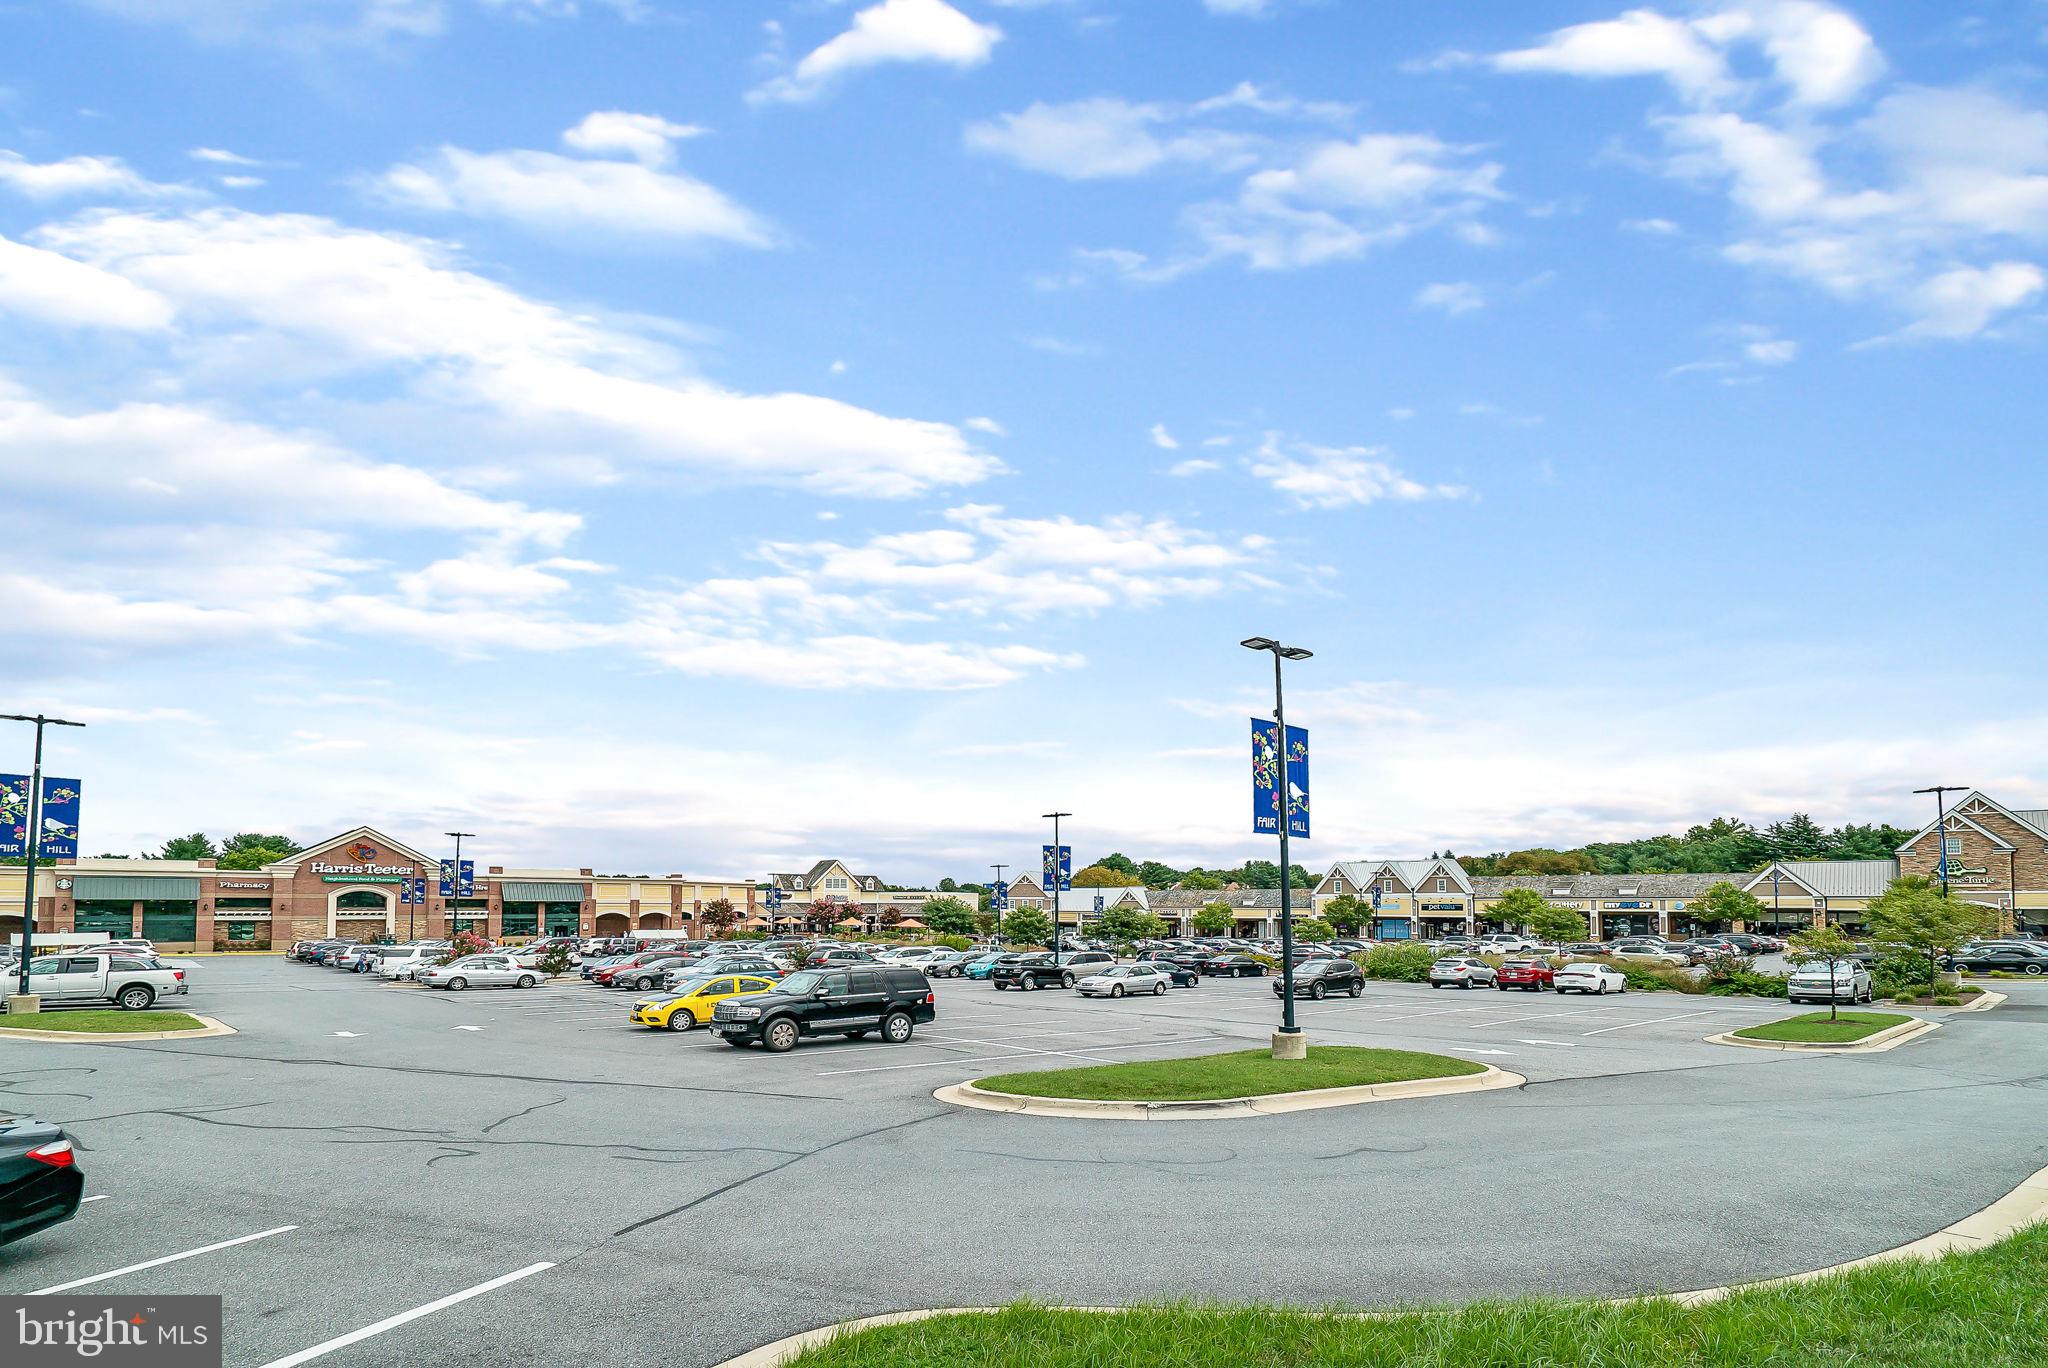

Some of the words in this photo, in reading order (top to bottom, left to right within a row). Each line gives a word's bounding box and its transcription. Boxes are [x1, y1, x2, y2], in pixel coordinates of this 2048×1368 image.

[1257, 817, 1276, 828] FAIR
[1291, 820, 1307, 832] HILL
[0, 844, 19, 853] AIR
[46, 845, 72, 854] HILL
[310, 862, 363, 874] Harris
[364, 863, 413, 875] Teeter
[1965, 875, 1995, 885] Turtle
[219, 881, 270, 890] Pharmacy
